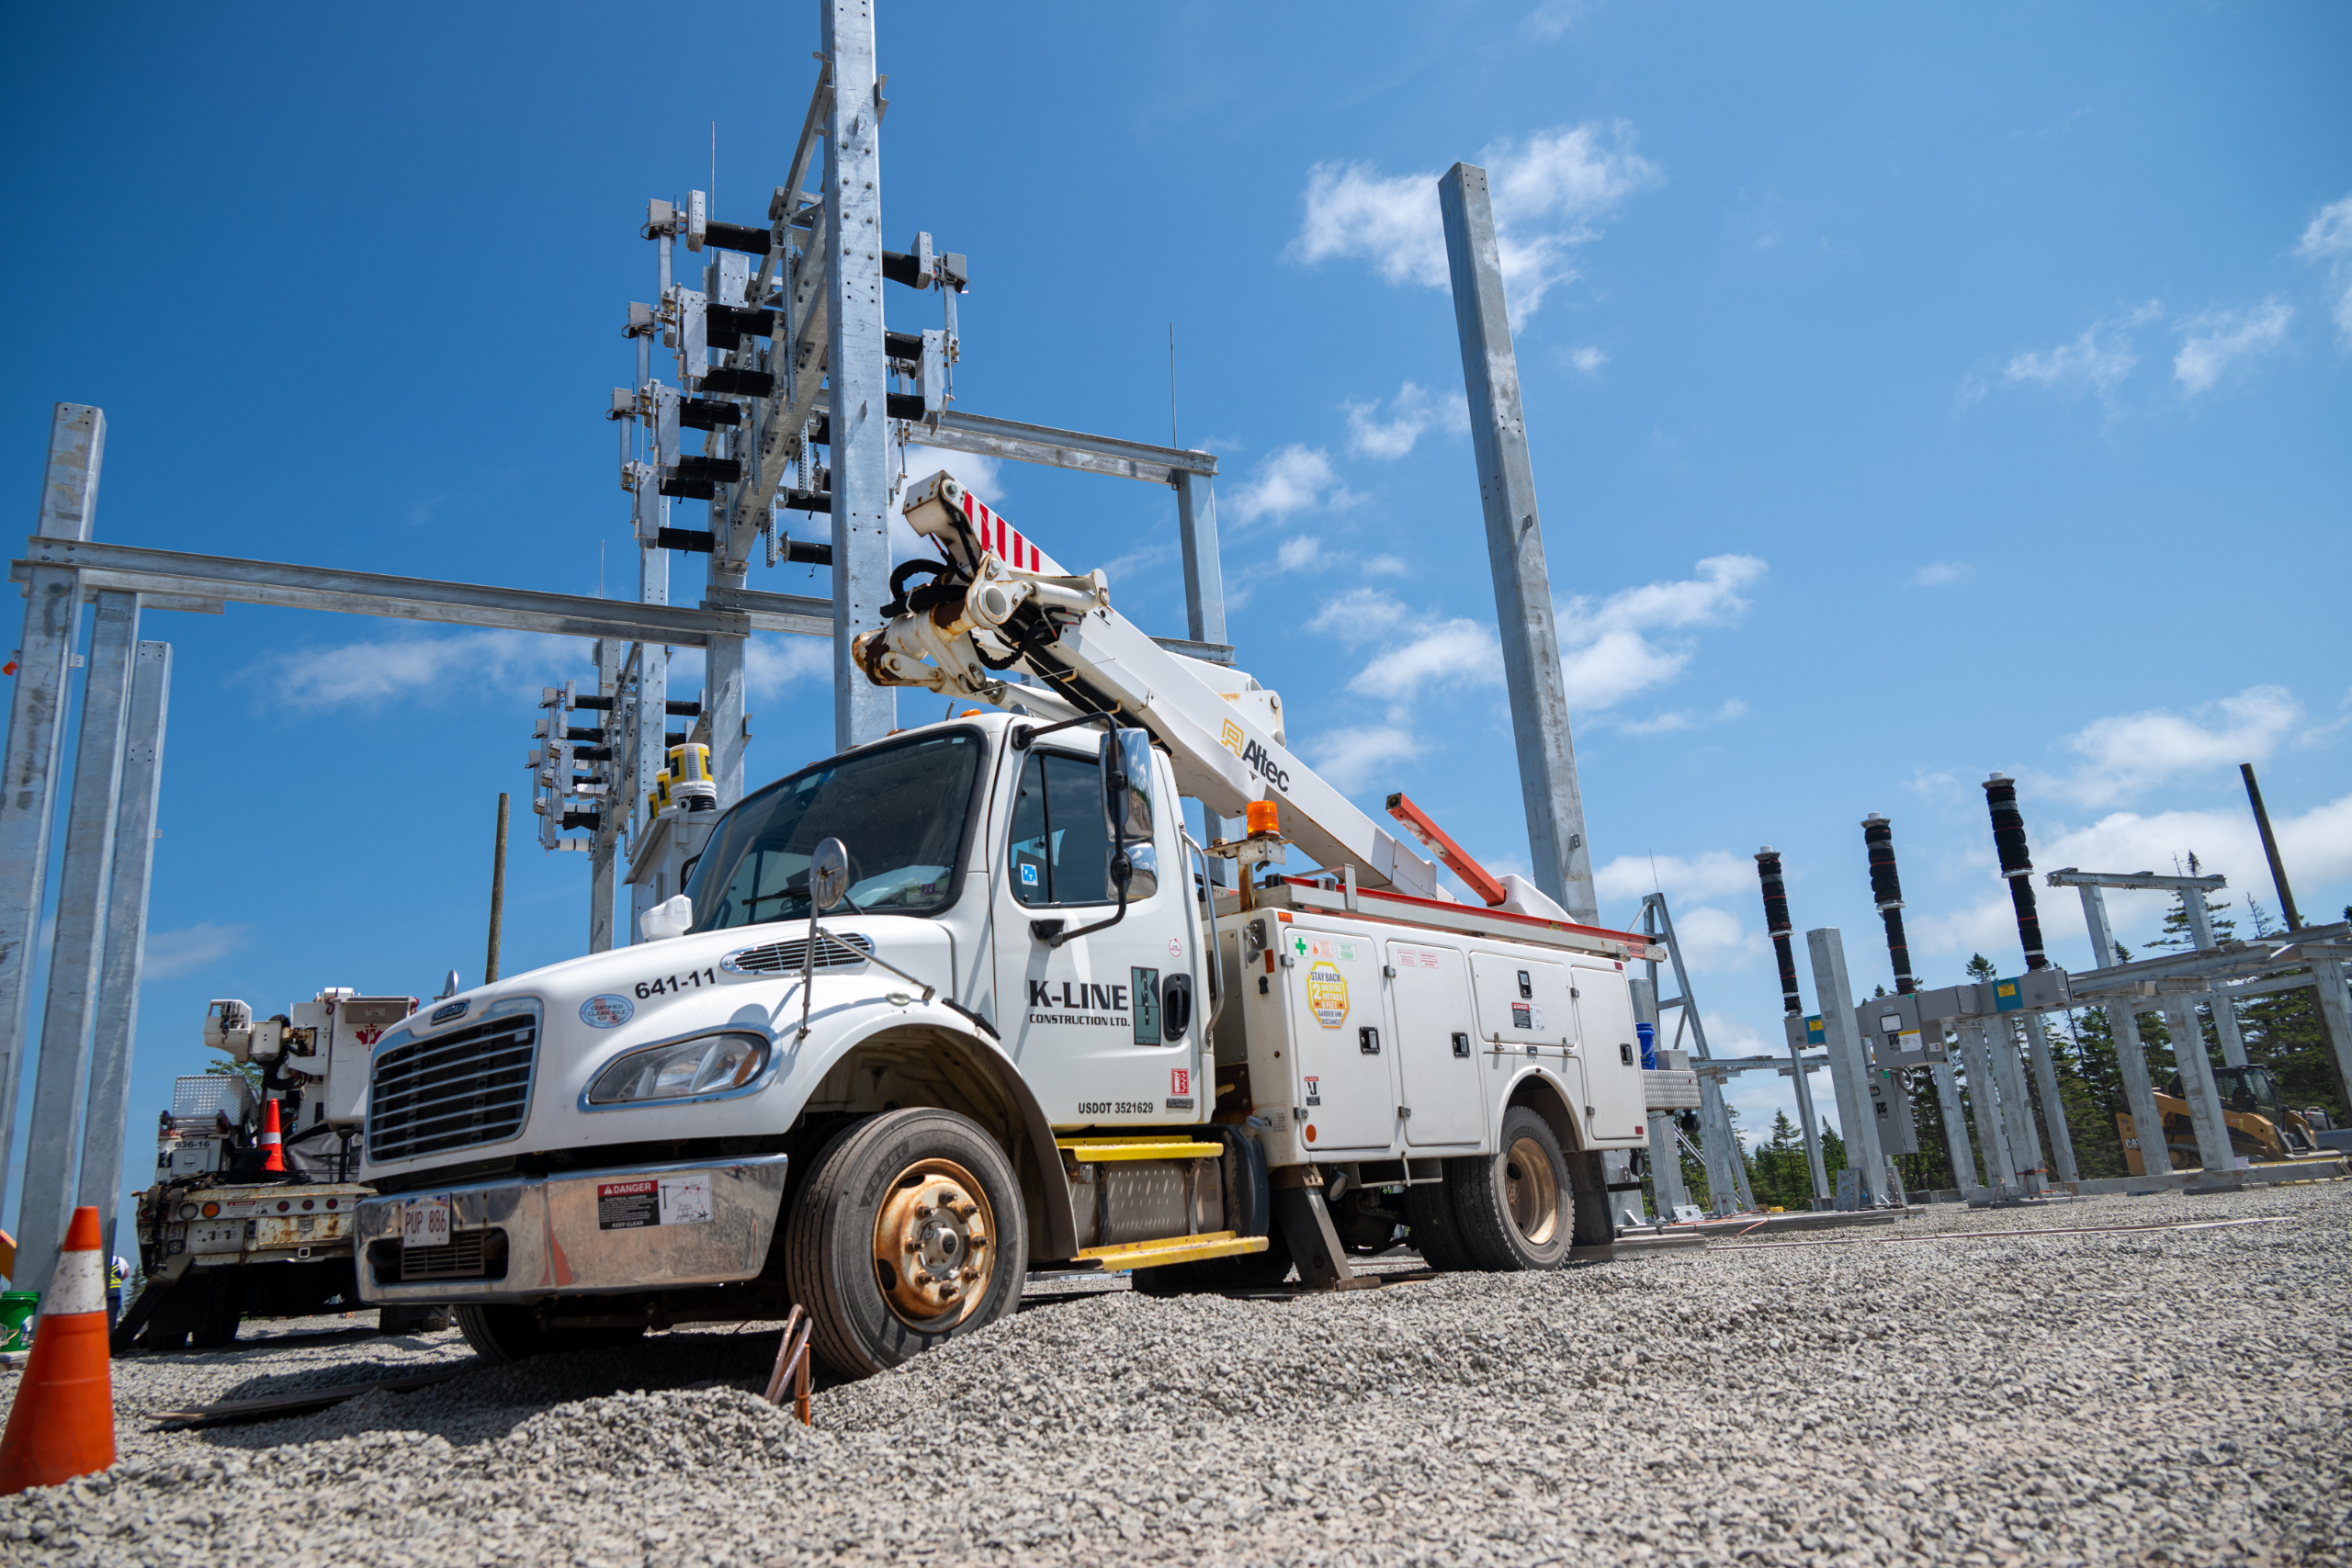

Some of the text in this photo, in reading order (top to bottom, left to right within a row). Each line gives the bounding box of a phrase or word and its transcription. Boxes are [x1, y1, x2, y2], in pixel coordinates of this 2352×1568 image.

[1241, 739, 1290, 793] Altec
[634, 967, 716, 999] 641-11
[1310, 971, 1341, 983] STAY BACK
[1029, 979, 1129, 1011] K-LINE
[1312, 983, 1342, 1000] 2 METERS
[590, 1003, 624, 1011] CERTIFIED
[1321, 1000, 1338, 1010] 6 FEET
[1029, 1013, 1131, 1027] CONSTRUCTION LTD.
[1317, 1010, 1335, 1018] GARDER
[1321, 1018, 1341, 1026] DISTANCE
[1078, 1101, 1113, 1114] USDOT
[1114, 1101, 1154, 1113] 3521629
[175, 1140, 210, 1148] 636-16
[613, 1181, 651, 1194] DANGER
[405, 1209, 447, 1235] PUP 886
